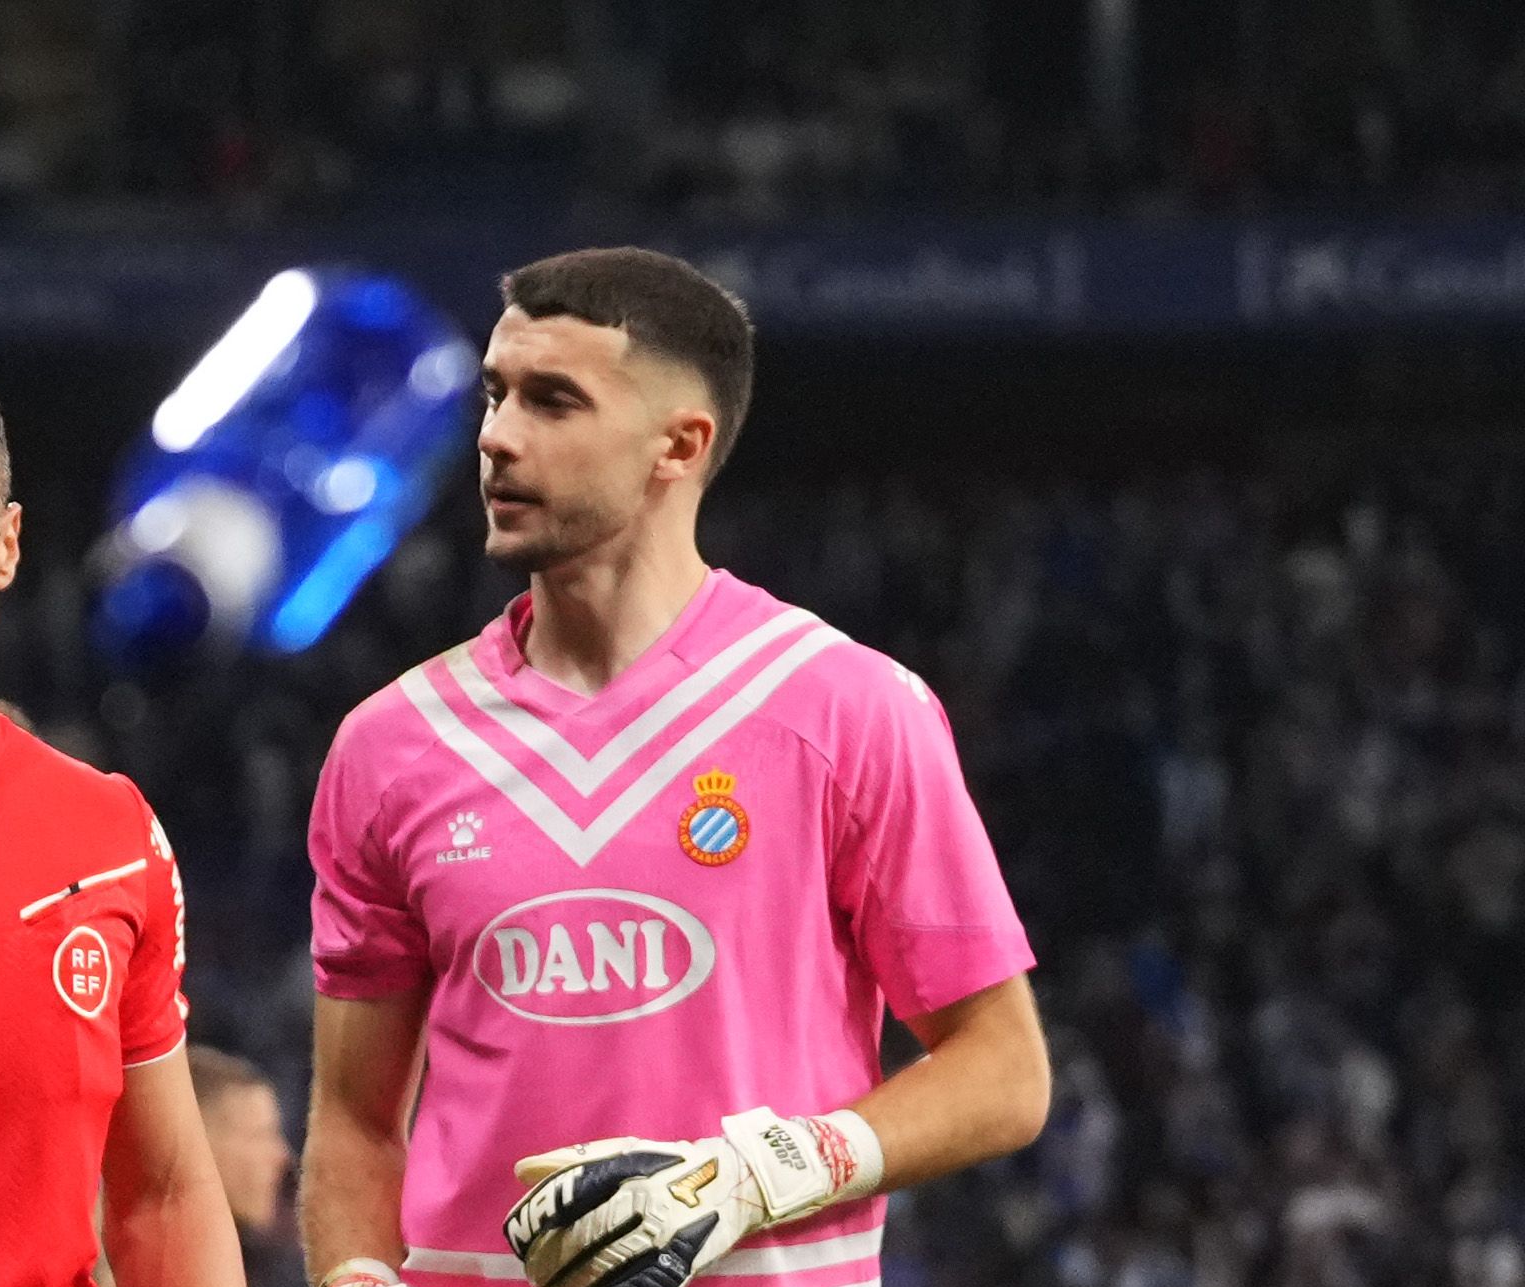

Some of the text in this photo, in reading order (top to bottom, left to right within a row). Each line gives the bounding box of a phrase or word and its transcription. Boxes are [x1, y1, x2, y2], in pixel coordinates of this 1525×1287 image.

[436, 845, 492, 864] KELME
[71, 947, 101, 969] RF
[493, 918, 670, 996] DANI
[72, 973, 102, 995] EF
